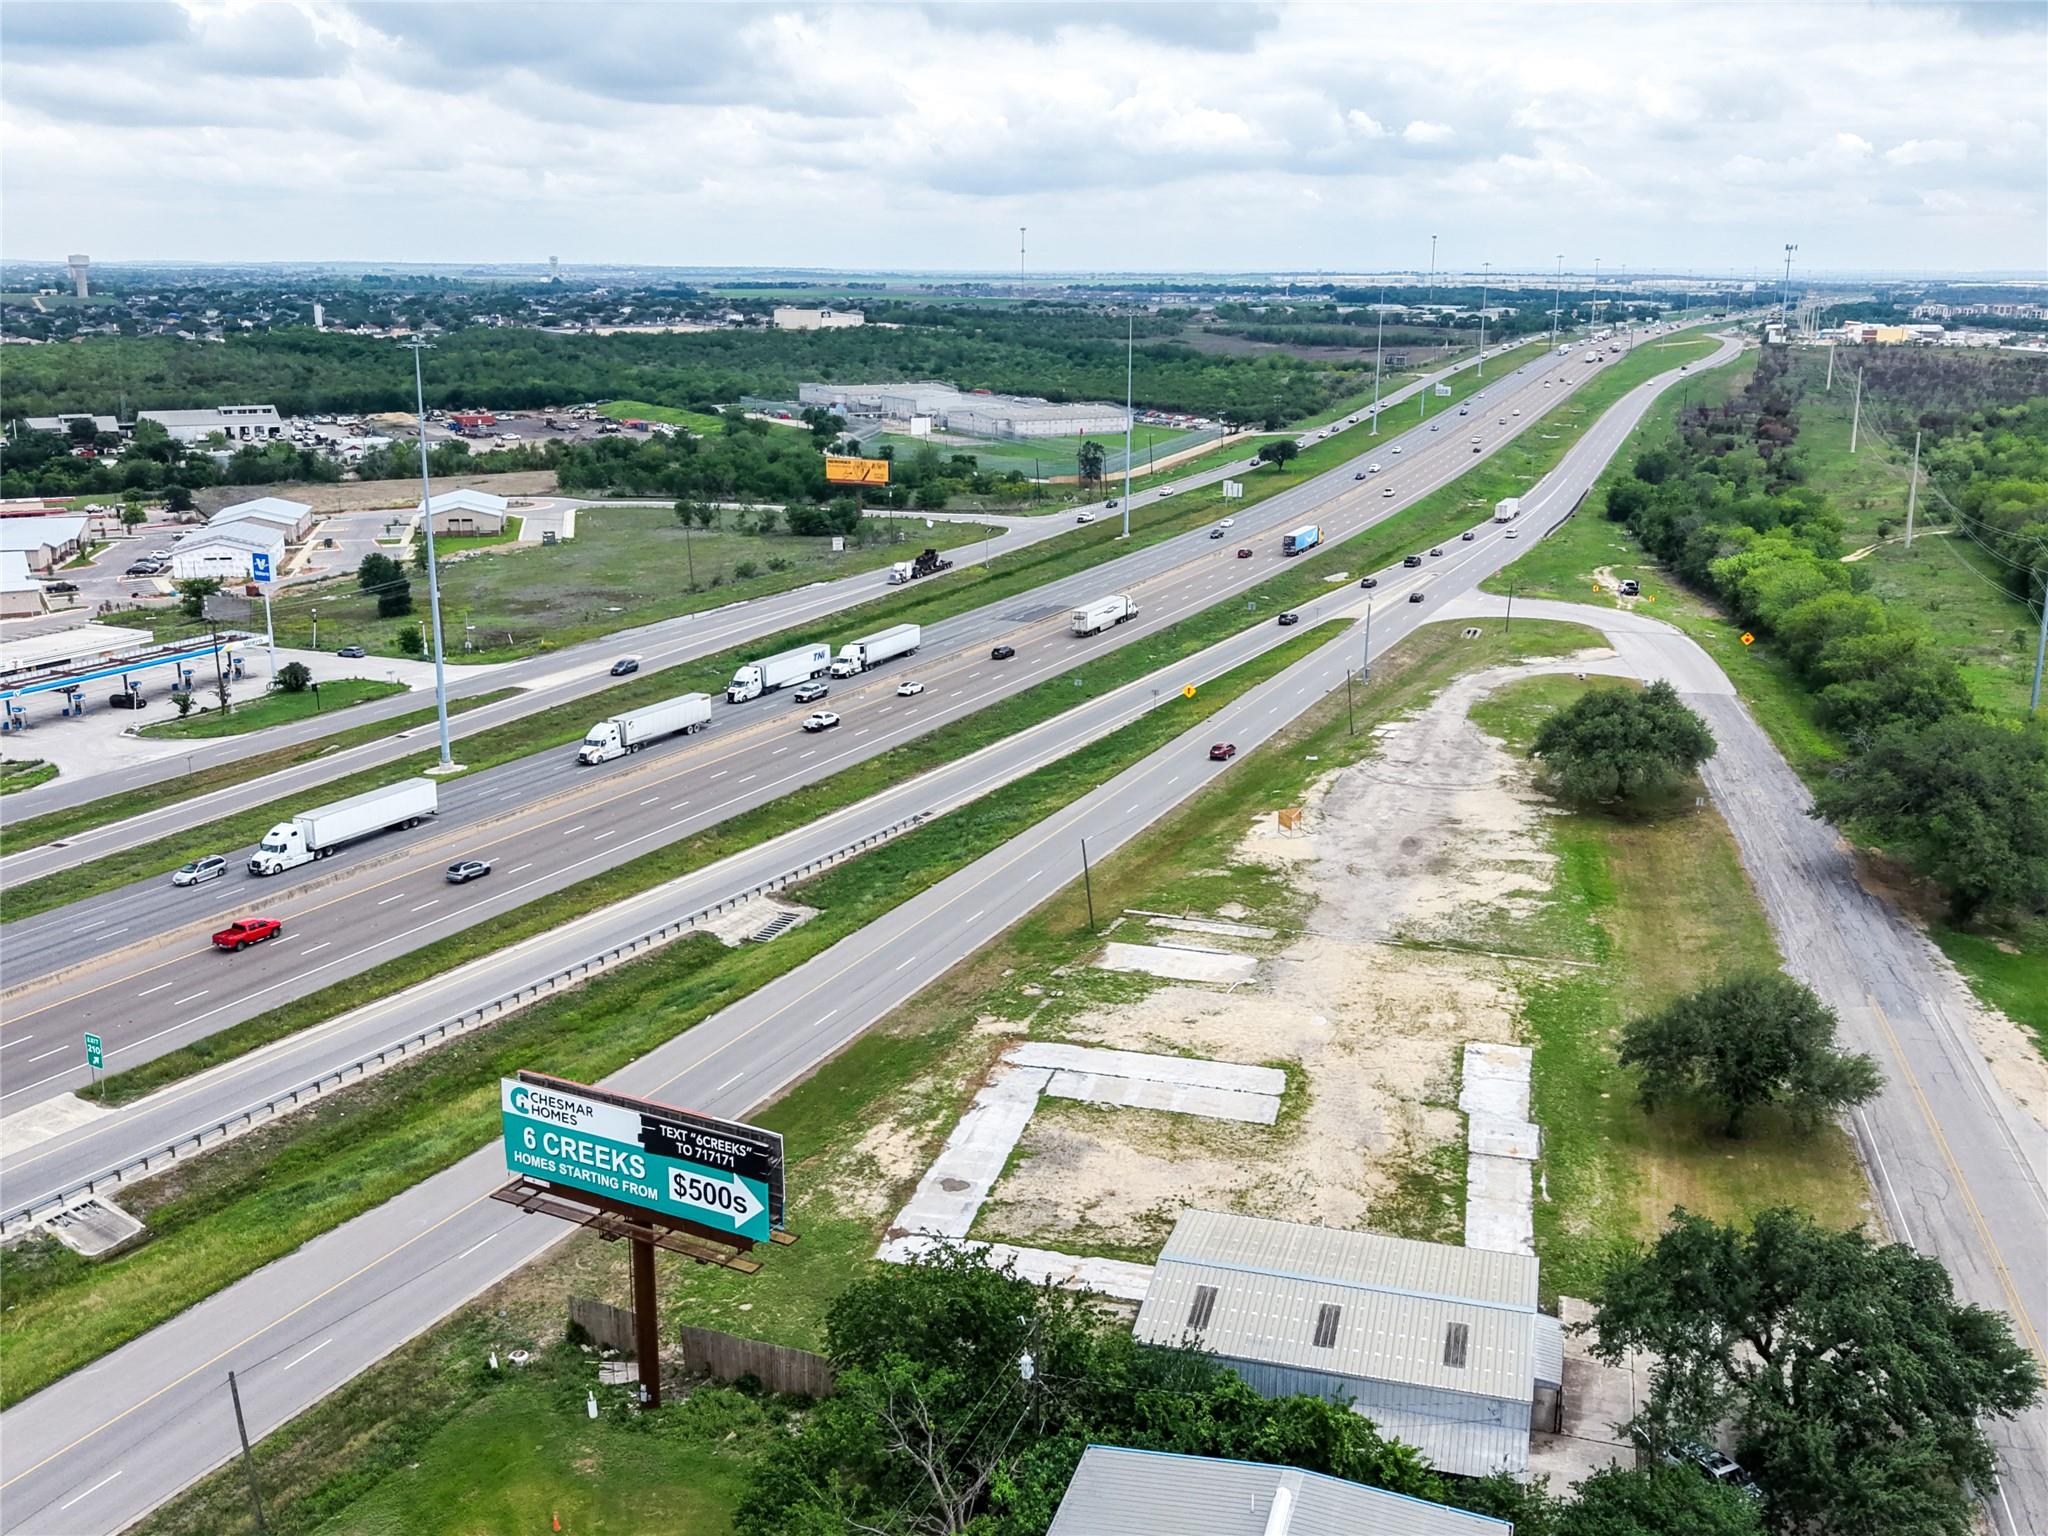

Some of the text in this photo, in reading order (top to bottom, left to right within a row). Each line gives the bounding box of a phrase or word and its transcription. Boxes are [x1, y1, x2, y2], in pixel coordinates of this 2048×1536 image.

[87, 1044, 101, 1055] 210
[530, 1092, 594, 1118] CHESMAR
[531, 1104, 578, 1126] HOMES
[659, 1124, 688, 1141] TEXT
[523, 1126, 646, 1179] 6 CREEKS
[676, 1142, 735, 1168] TO 717171
[514, 1150, 658, 1200] HOMES STARTING FROM
